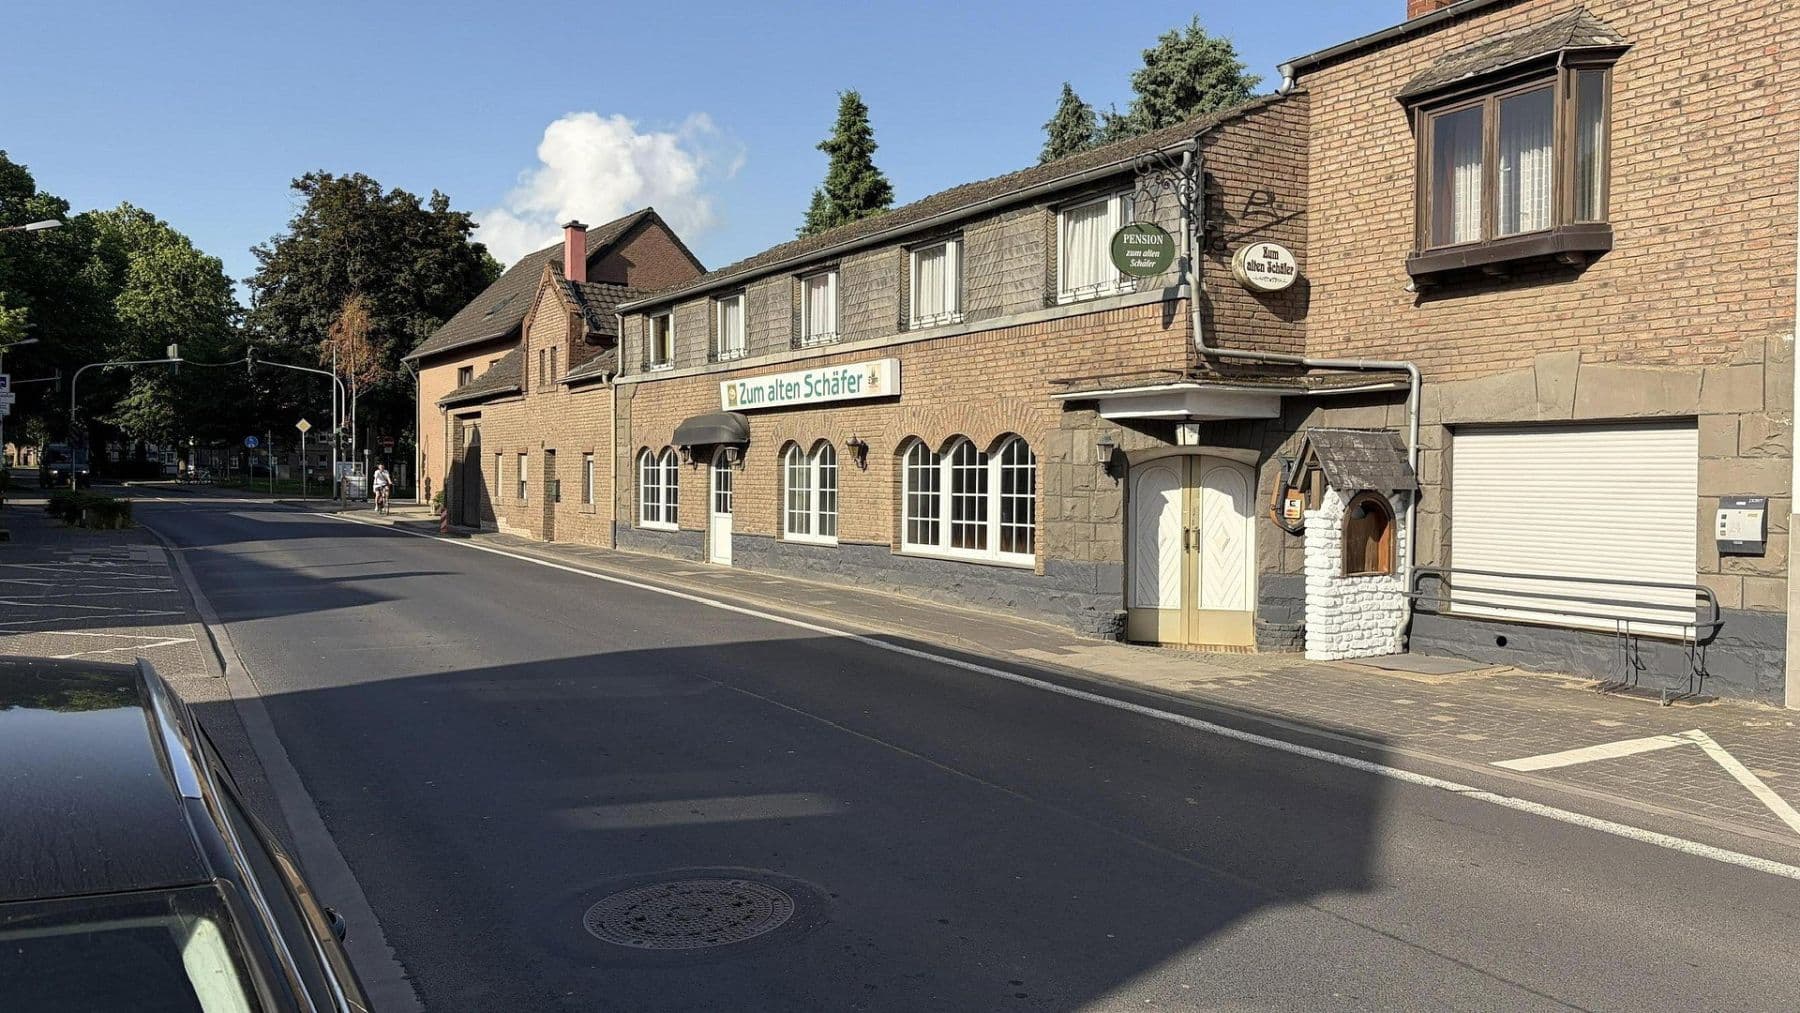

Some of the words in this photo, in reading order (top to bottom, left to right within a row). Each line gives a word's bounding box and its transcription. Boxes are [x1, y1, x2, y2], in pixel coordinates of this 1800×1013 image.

[1123, 233, 1164, 245] PENSION
[1142, 249, 1161, 258] alten
[1262, 246, 1279, 260] Zum
[1130, 258, 1157, 268] Schäfer
[1246, 260, 1265, 273] alten
[1266, 261, 1294, 276] Schäfer
[739, 382, 765, 405] Zum
[767, 378, 801, 402] alten
[803, 368, 863, 399] Schäfer
